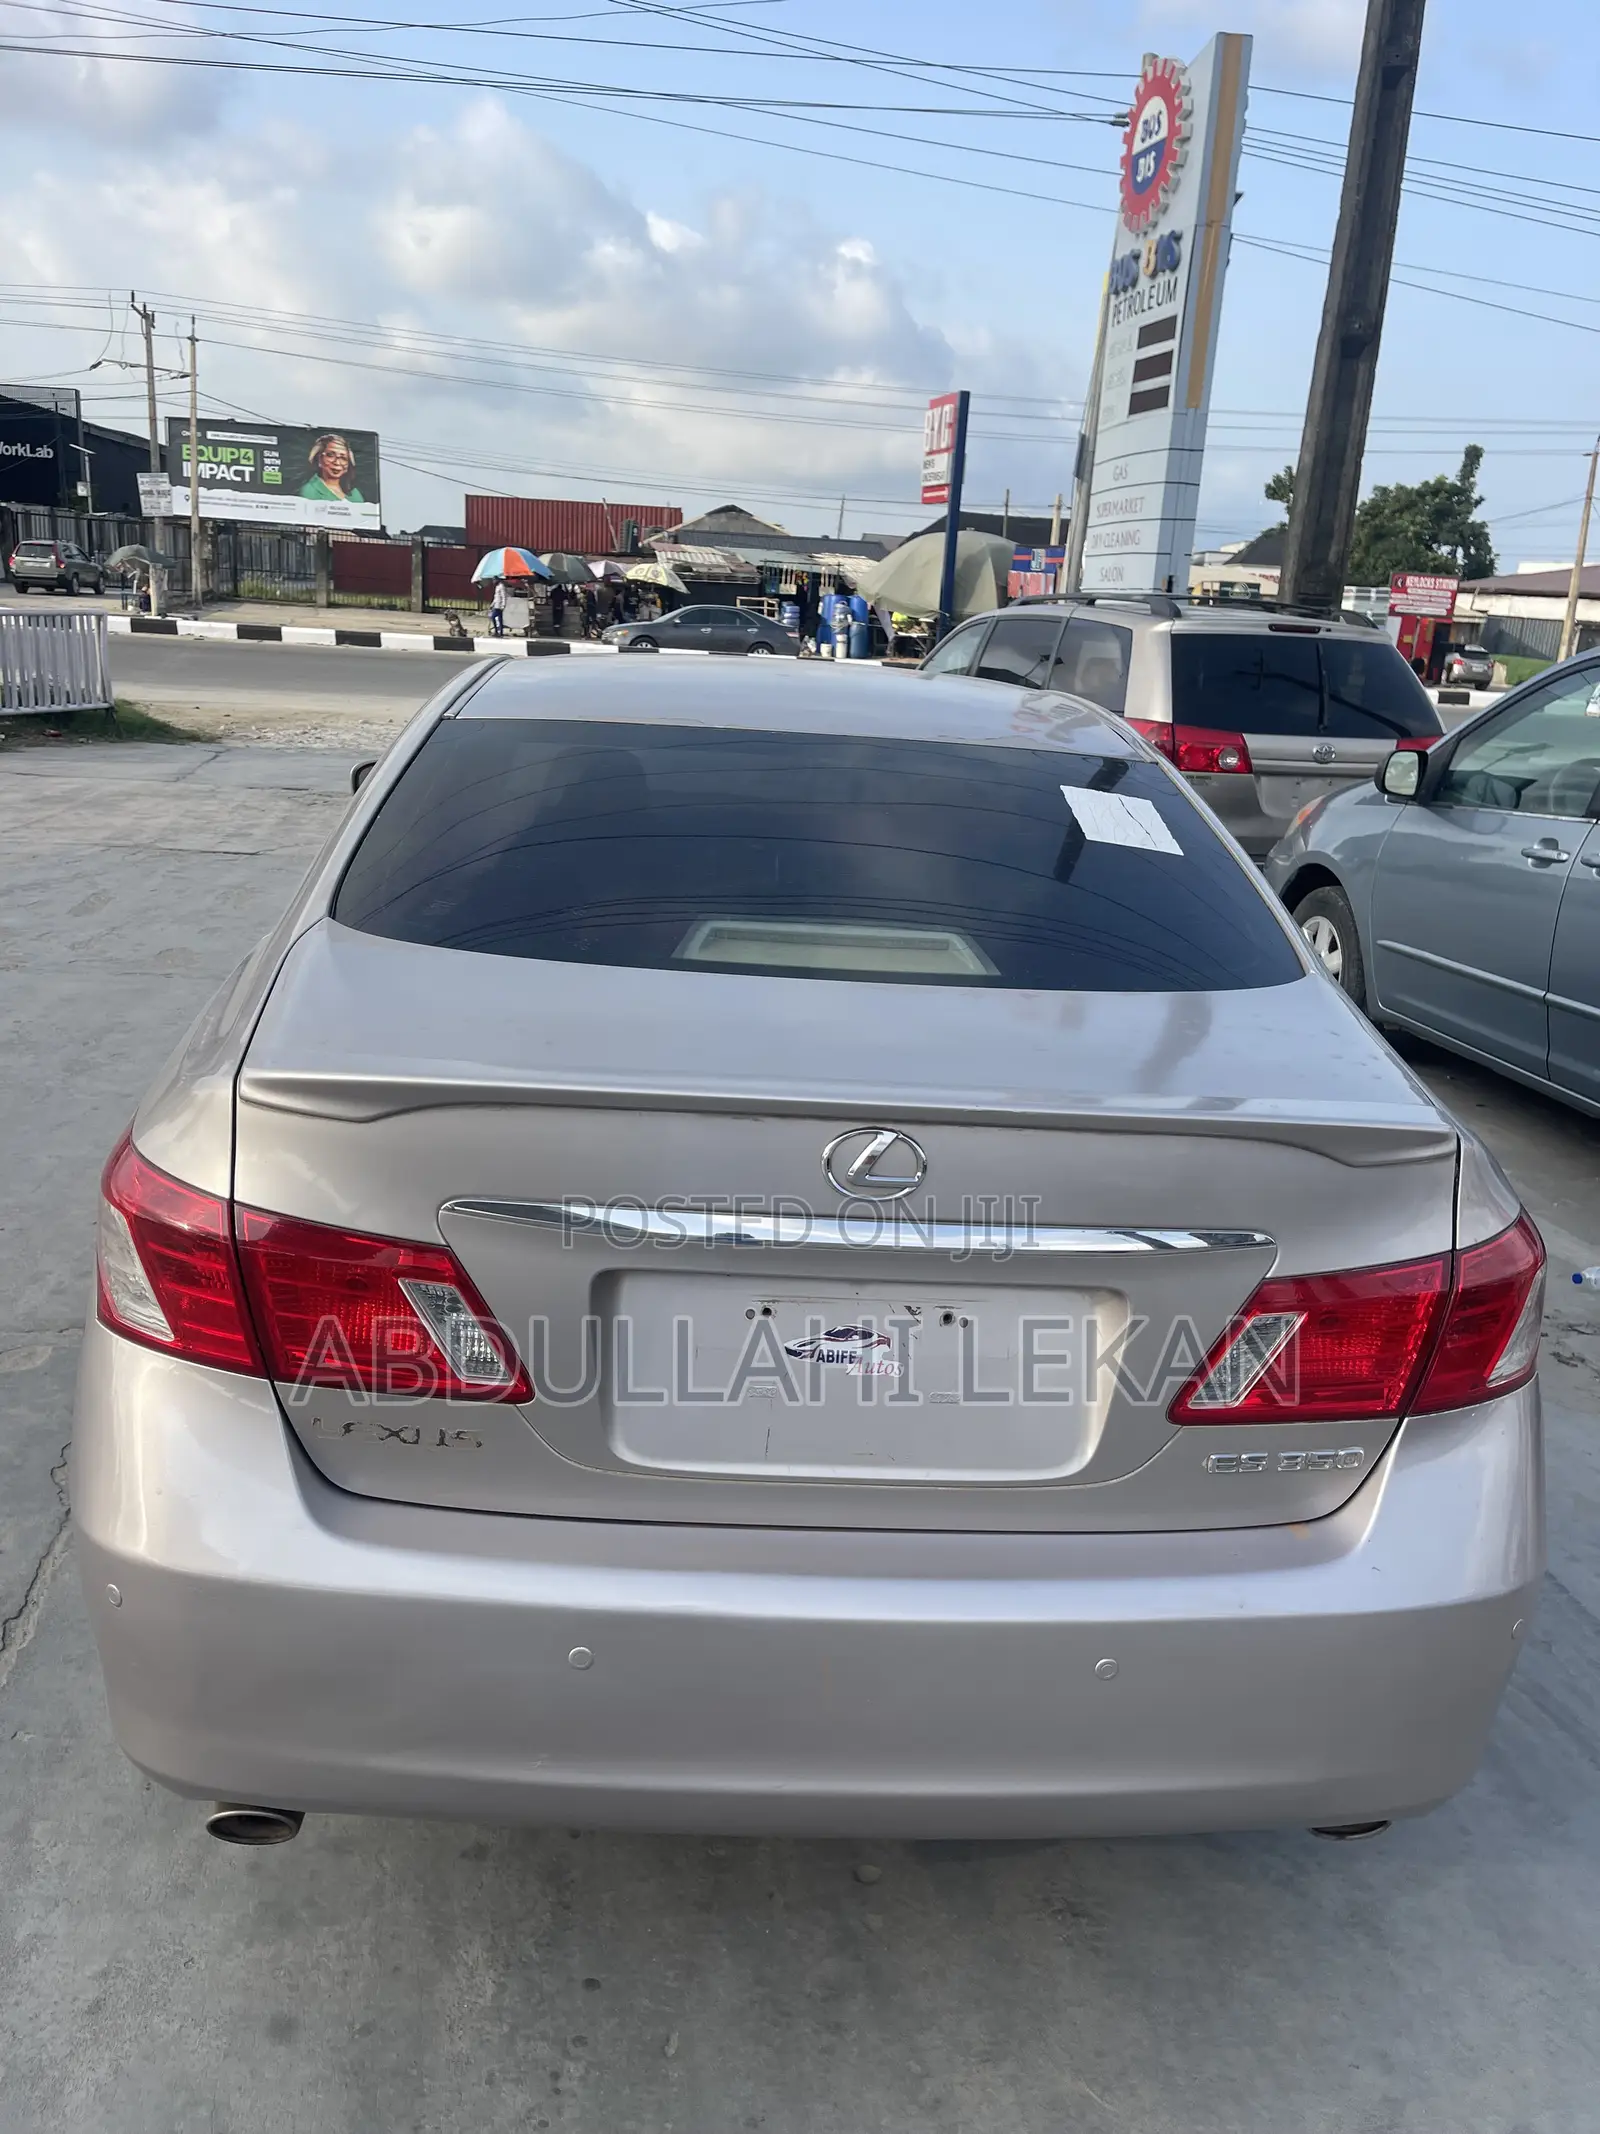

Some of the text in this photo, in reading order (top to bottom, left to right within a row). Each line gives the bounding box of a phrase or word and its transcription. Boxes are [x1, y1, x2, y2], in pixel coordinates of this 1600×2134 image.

[1112, 276, 1178, 328] PETROLEUM
[0, 441, 54, 459] orkLab
[181, 444, 239, 463] EQUIP
[182, 461, 255, 483] IMPACT
[1112, 464, 1129, 482] GAS
[1096, 496, 1146, 520] SUPERMARKET
[1102, 529, 1141, 548] CLEANING
[1099, 566, 1124, 583] SALON
[847, 1356, 904, 1376] Autos
[1206, 1446, 1366, 1475] ES 350
